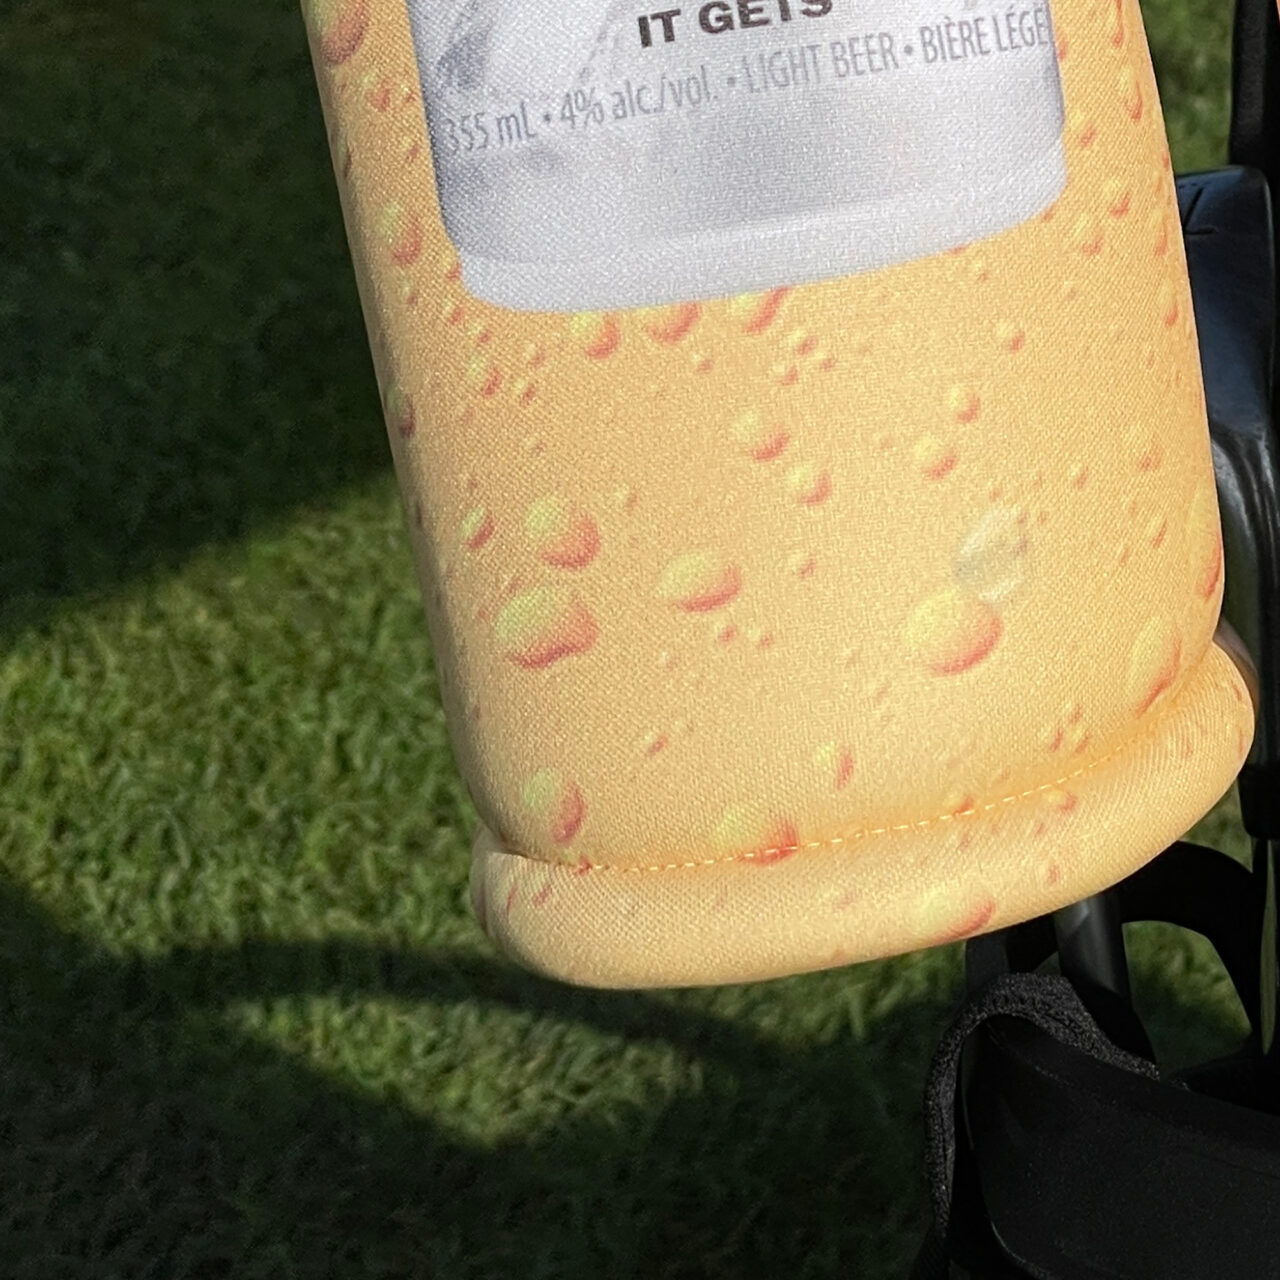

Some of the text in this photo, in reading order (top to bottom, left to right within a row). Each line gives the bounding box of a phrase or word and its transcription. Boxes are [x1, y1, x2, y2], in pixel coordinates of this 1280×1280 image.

[637, 8, 682, 49] IT
[560, 86, 605, 130] 4%
[741, 43, 823, 94] LIGHT
[830, 31, 900, 78] BEER
[918, 15, 992, 64] BIÈRE
